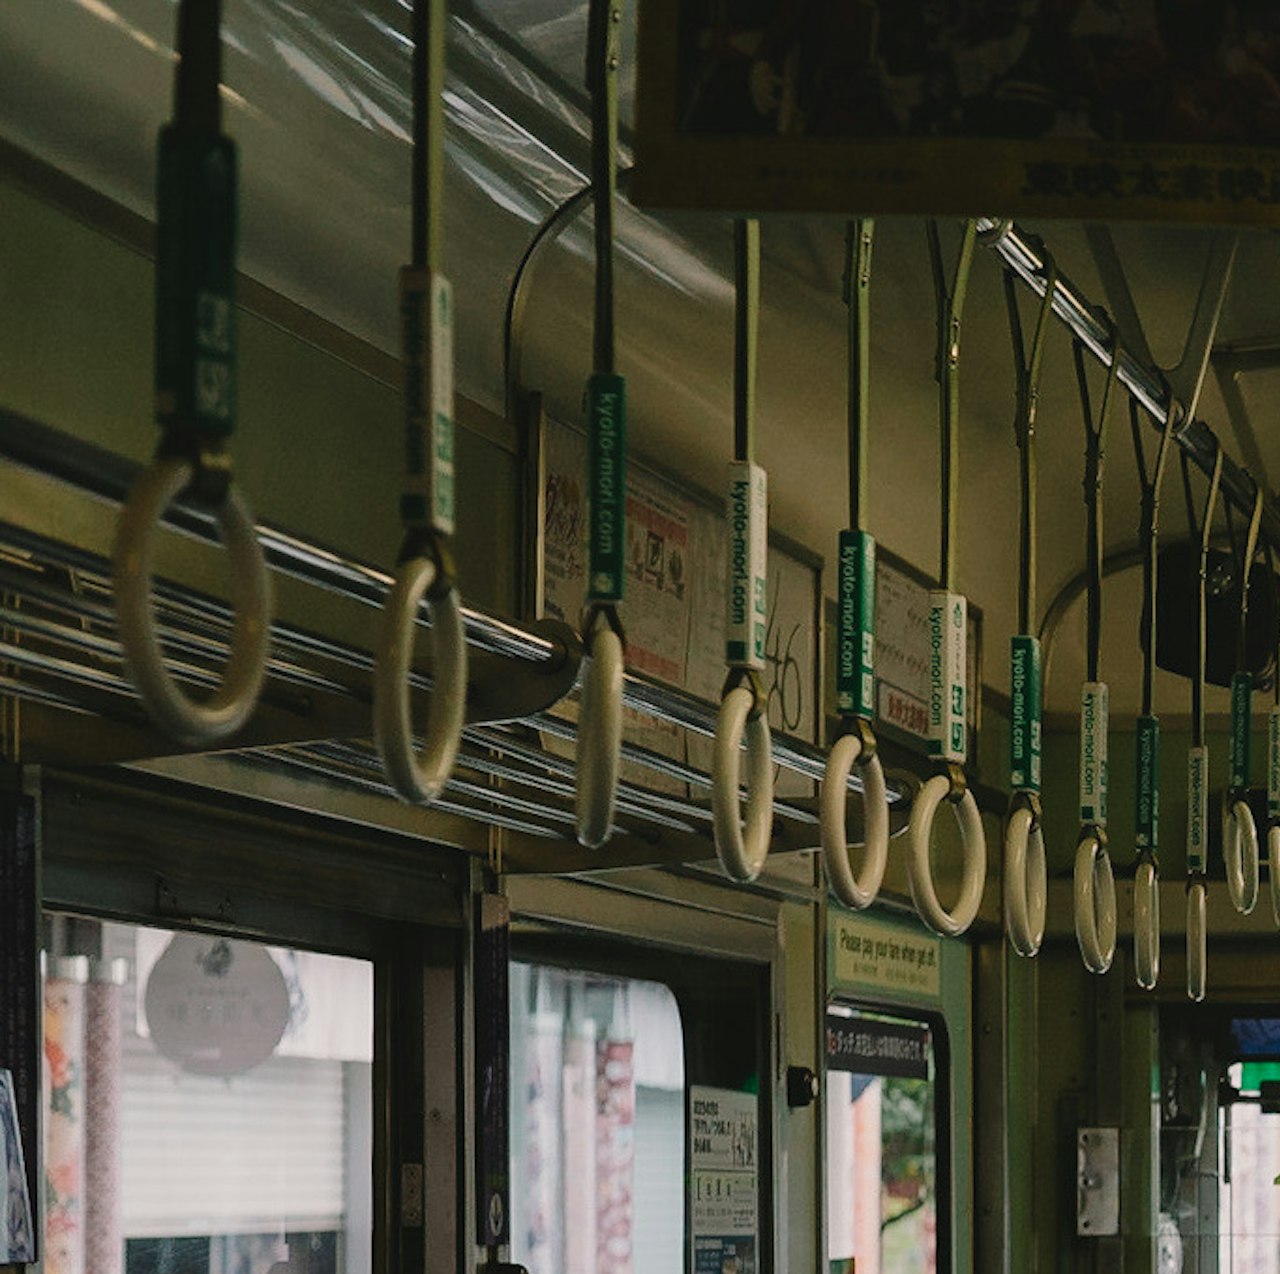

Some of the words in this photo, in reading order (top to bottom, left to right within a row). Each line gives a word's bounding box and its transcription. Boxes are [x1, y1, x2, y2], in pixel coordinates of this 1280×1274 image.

[598, 392, 619, 556] kyoto-mori.com
[732, 480, 749, 626] kyoto-mori.com
[840, 545, 860, 680] kyoto-mori.com
[928, 606, 944, 727] kyoto-mori.com
[1012, 648, 1028, 762] kyoto-mori.com
[1082, 692, 1096, 798] kyoto-mori.com
